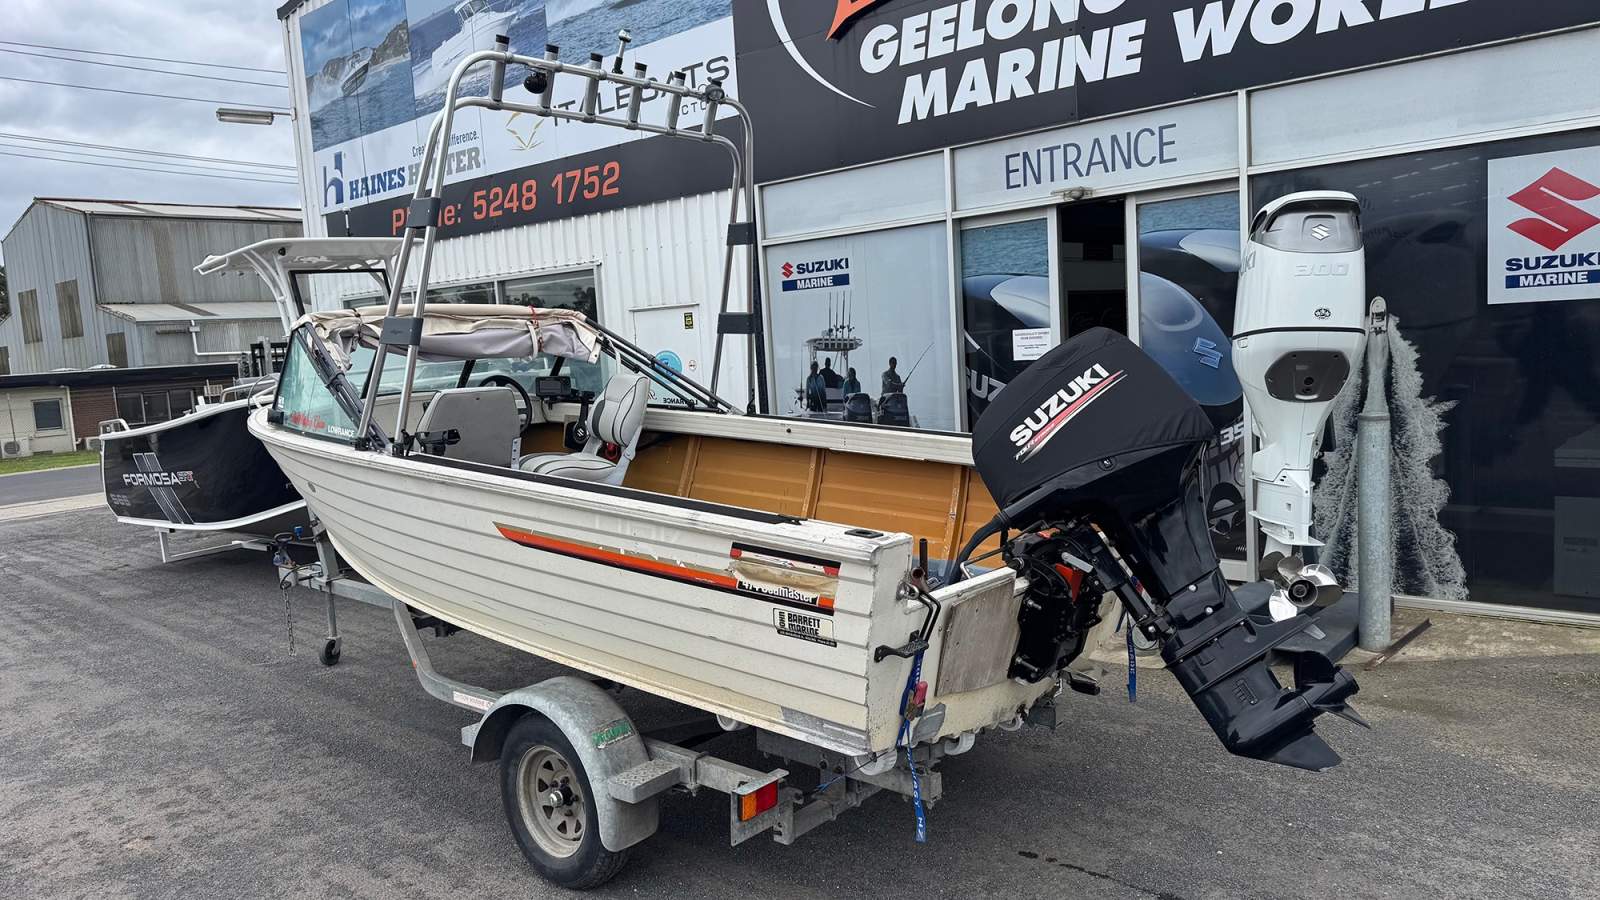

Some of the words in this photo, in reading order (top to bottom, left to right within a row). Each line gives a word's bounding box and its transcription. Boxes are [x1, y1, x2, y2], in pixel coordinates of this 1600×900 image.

[859, 0, 1126, 73] GEELON
[898, 19, 1147, 124] MARINE
[1172, 0, 1470, 63] WOR
[447, 129, 480, 147] ifference.
[349, 166, 406, 200] HAINES
[408, 146, 481, 186] HTER
[1005, 123, 1177, 190] ENTRANCE
[392, 204, 462, 236] Pe:
[473, 179, 537, 220] 5248
[551, 161, 620, 205] 1752
[796, 257, 849, 275] SUZUKI
[797, 276, 834, 290] MARINE
[1519, 271, 1589, 287] MARINE
[1009, 362, 1110, 447] SUZUKI
[122, 471, 182, 486] FORMOSA
[787, 612, 821, 629] BARRETT
